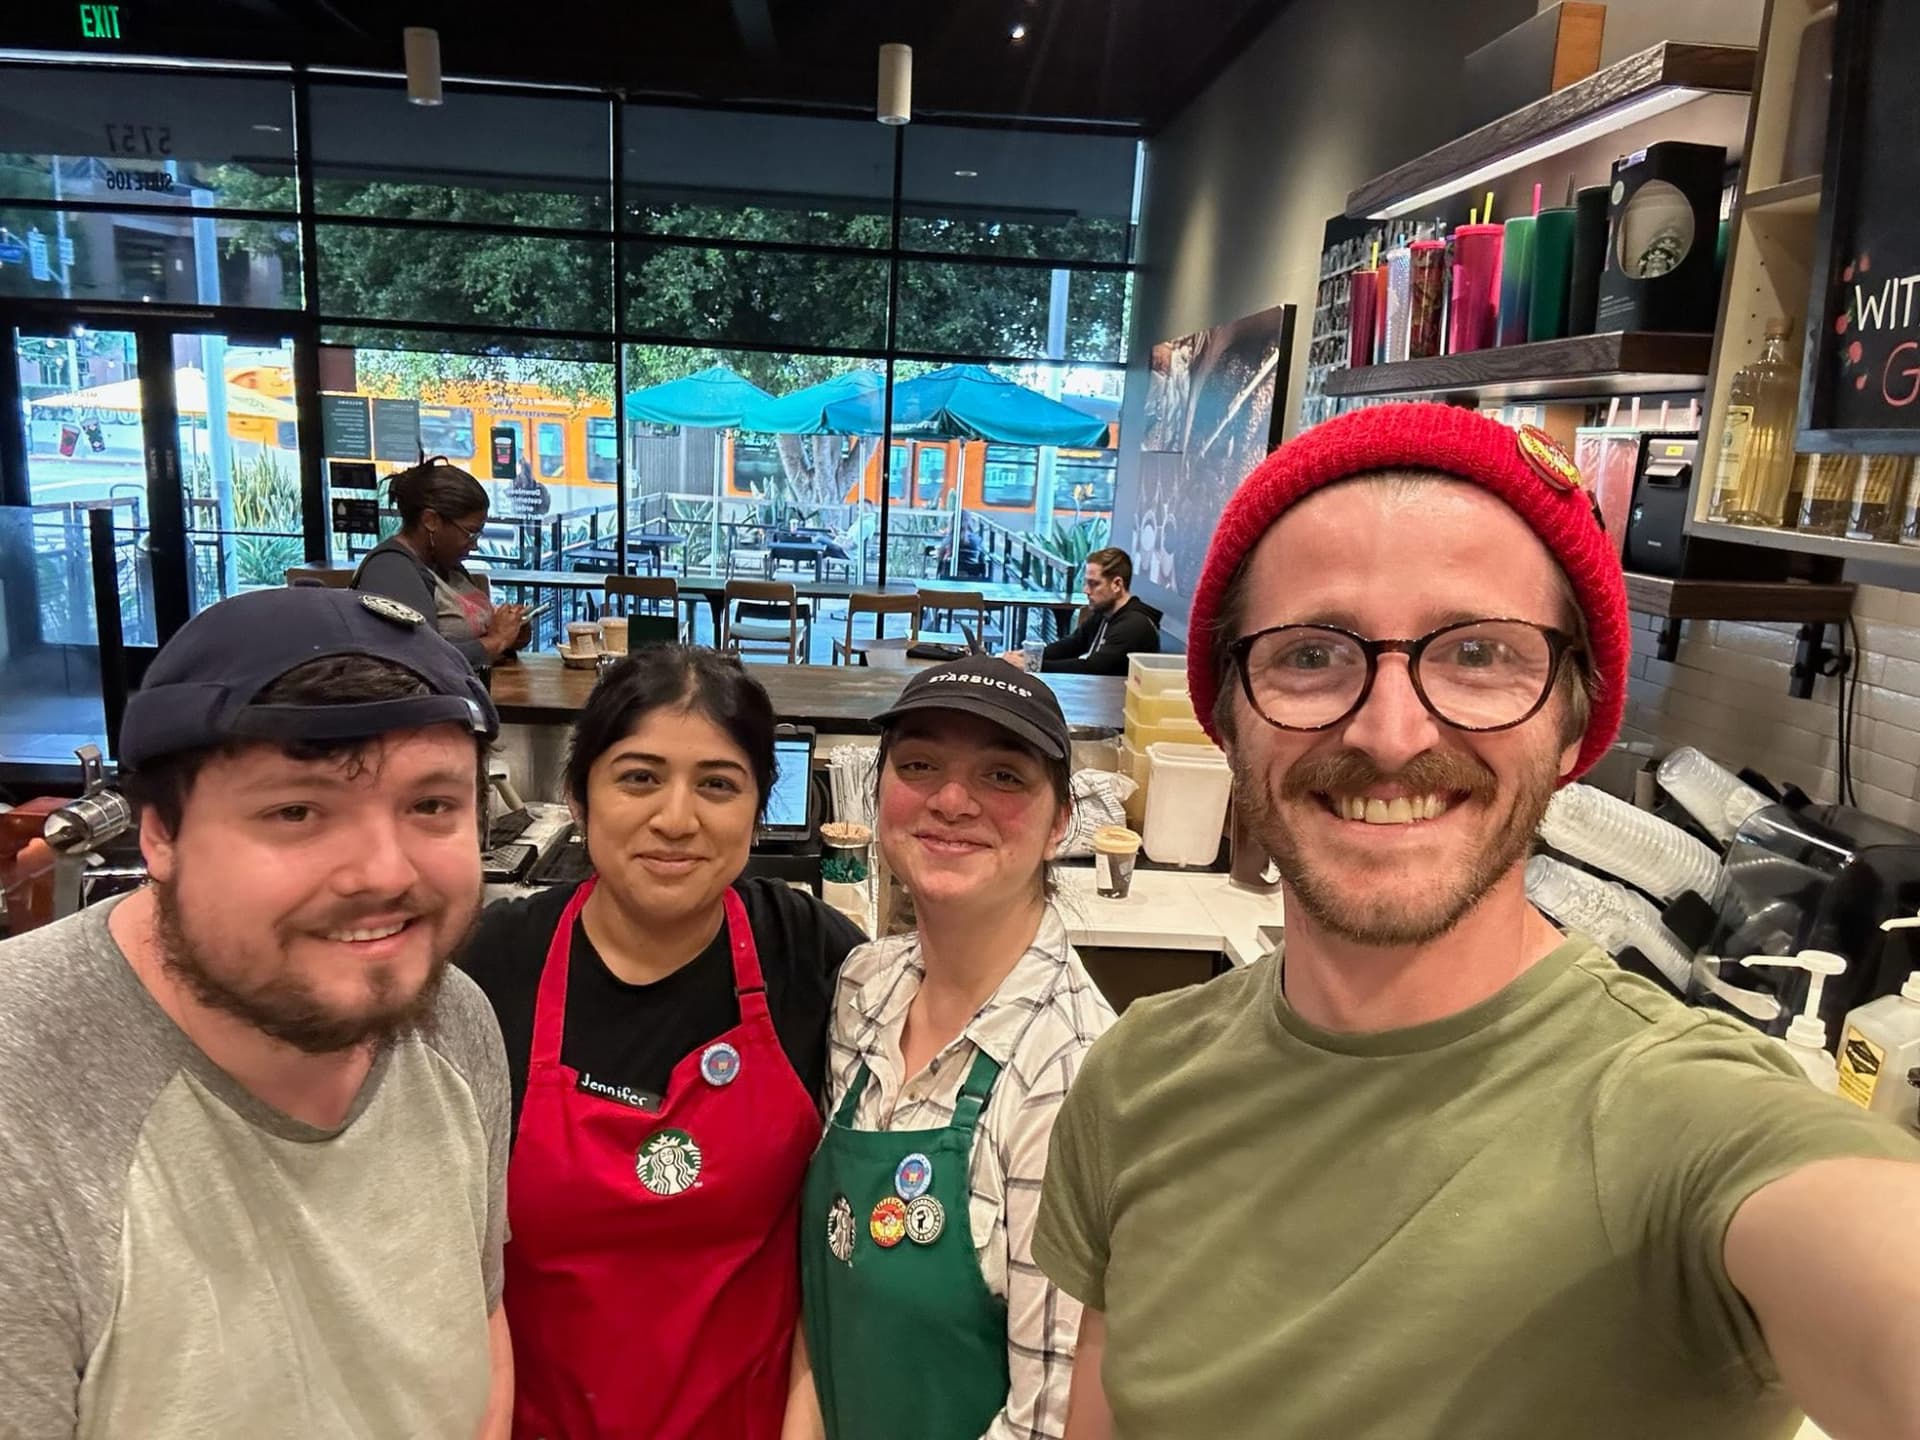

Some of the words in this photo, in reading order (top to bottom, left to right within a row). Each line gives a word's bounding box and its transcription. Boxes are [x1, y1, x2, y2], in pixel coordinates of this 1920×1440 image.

[80, 4, 120, 38] EXIT
[1855, 274, 1920, 332] WIT
[581, 1073, 648, 1106] Jennifer
